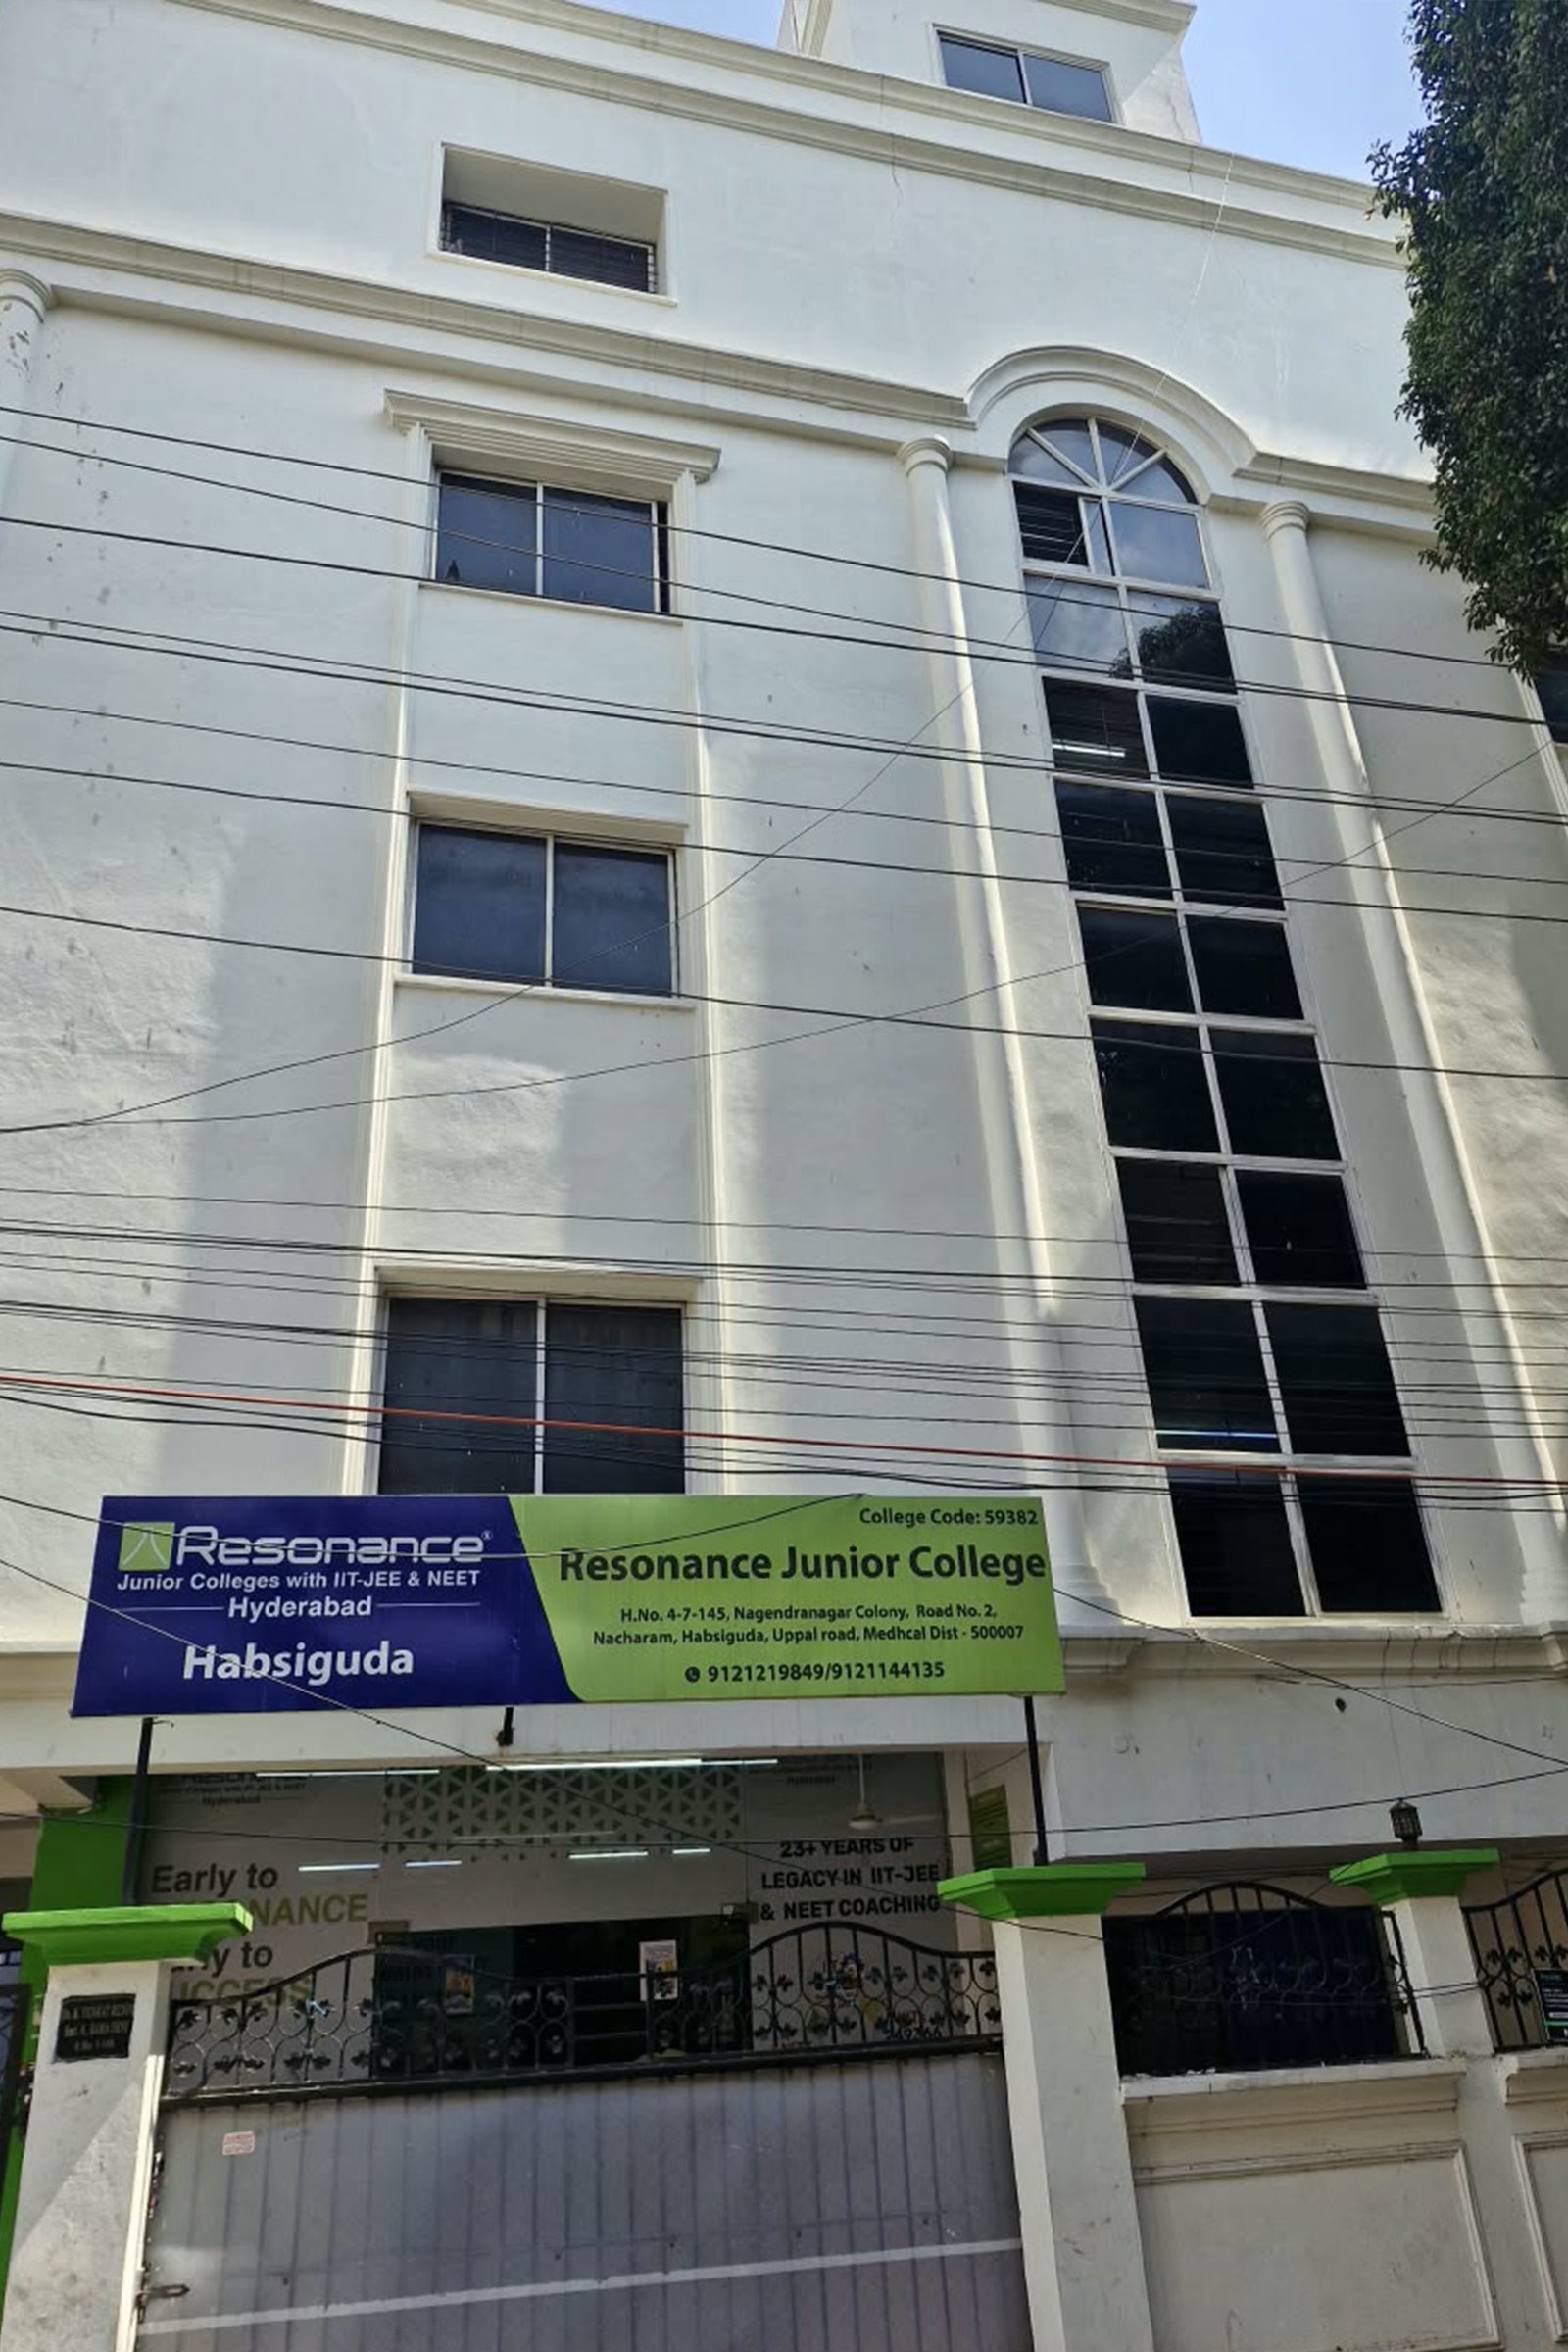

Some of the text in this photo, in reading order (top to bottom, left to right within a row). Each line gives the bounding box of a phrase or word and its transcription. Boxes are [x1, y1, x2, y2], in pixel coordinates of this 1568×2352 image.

[859, 1507, 1039, 1528] College Code: 59382
[560, 1544, 1046, 1586] Resonance Junior College
[118, 1570, 480, 1592] Junior Colleges with IIT-JEE & NEET
[228, 1596, 372, 1623] Hyderabad
[620, 1608, 663, 1622] H.No.
[667, 1607, 730, 1622] 4-7-145,
[734, 1605, 851, 1623] Nagendranagar
[855, 1604, 909, 1621] Colony,
[916, 1604, 954, 1618] Road
[957, 1603, 981, 1617] No.
[593, 1630, 677, 1645] Nacharam,
[682, 1628, 768, 1645] Habsiguda,
[773, 1627, 817, 1643] Uppal
[821, 1626, 859, 1642] road,
[863, 1626, 926, 1640] Medhcal
[930, 1625, 958, 1640] Dist
[970, 1625, 1024, 1639] 500007
[183, 1641, 414, 1686] Habsiguda
[708, 1662, 945, 1682] 9121219849/9121144135
[780, 1836, 914, 1859] 23+ YEARS OF
[151, 1862, 278, 1897] Early to
[761, 1864, 940, 1889] LEGACY IN IIT-JEE
[760, 1895, 940, 1921] & NEET COACHING
[241, 1941, 273, 1968] to
